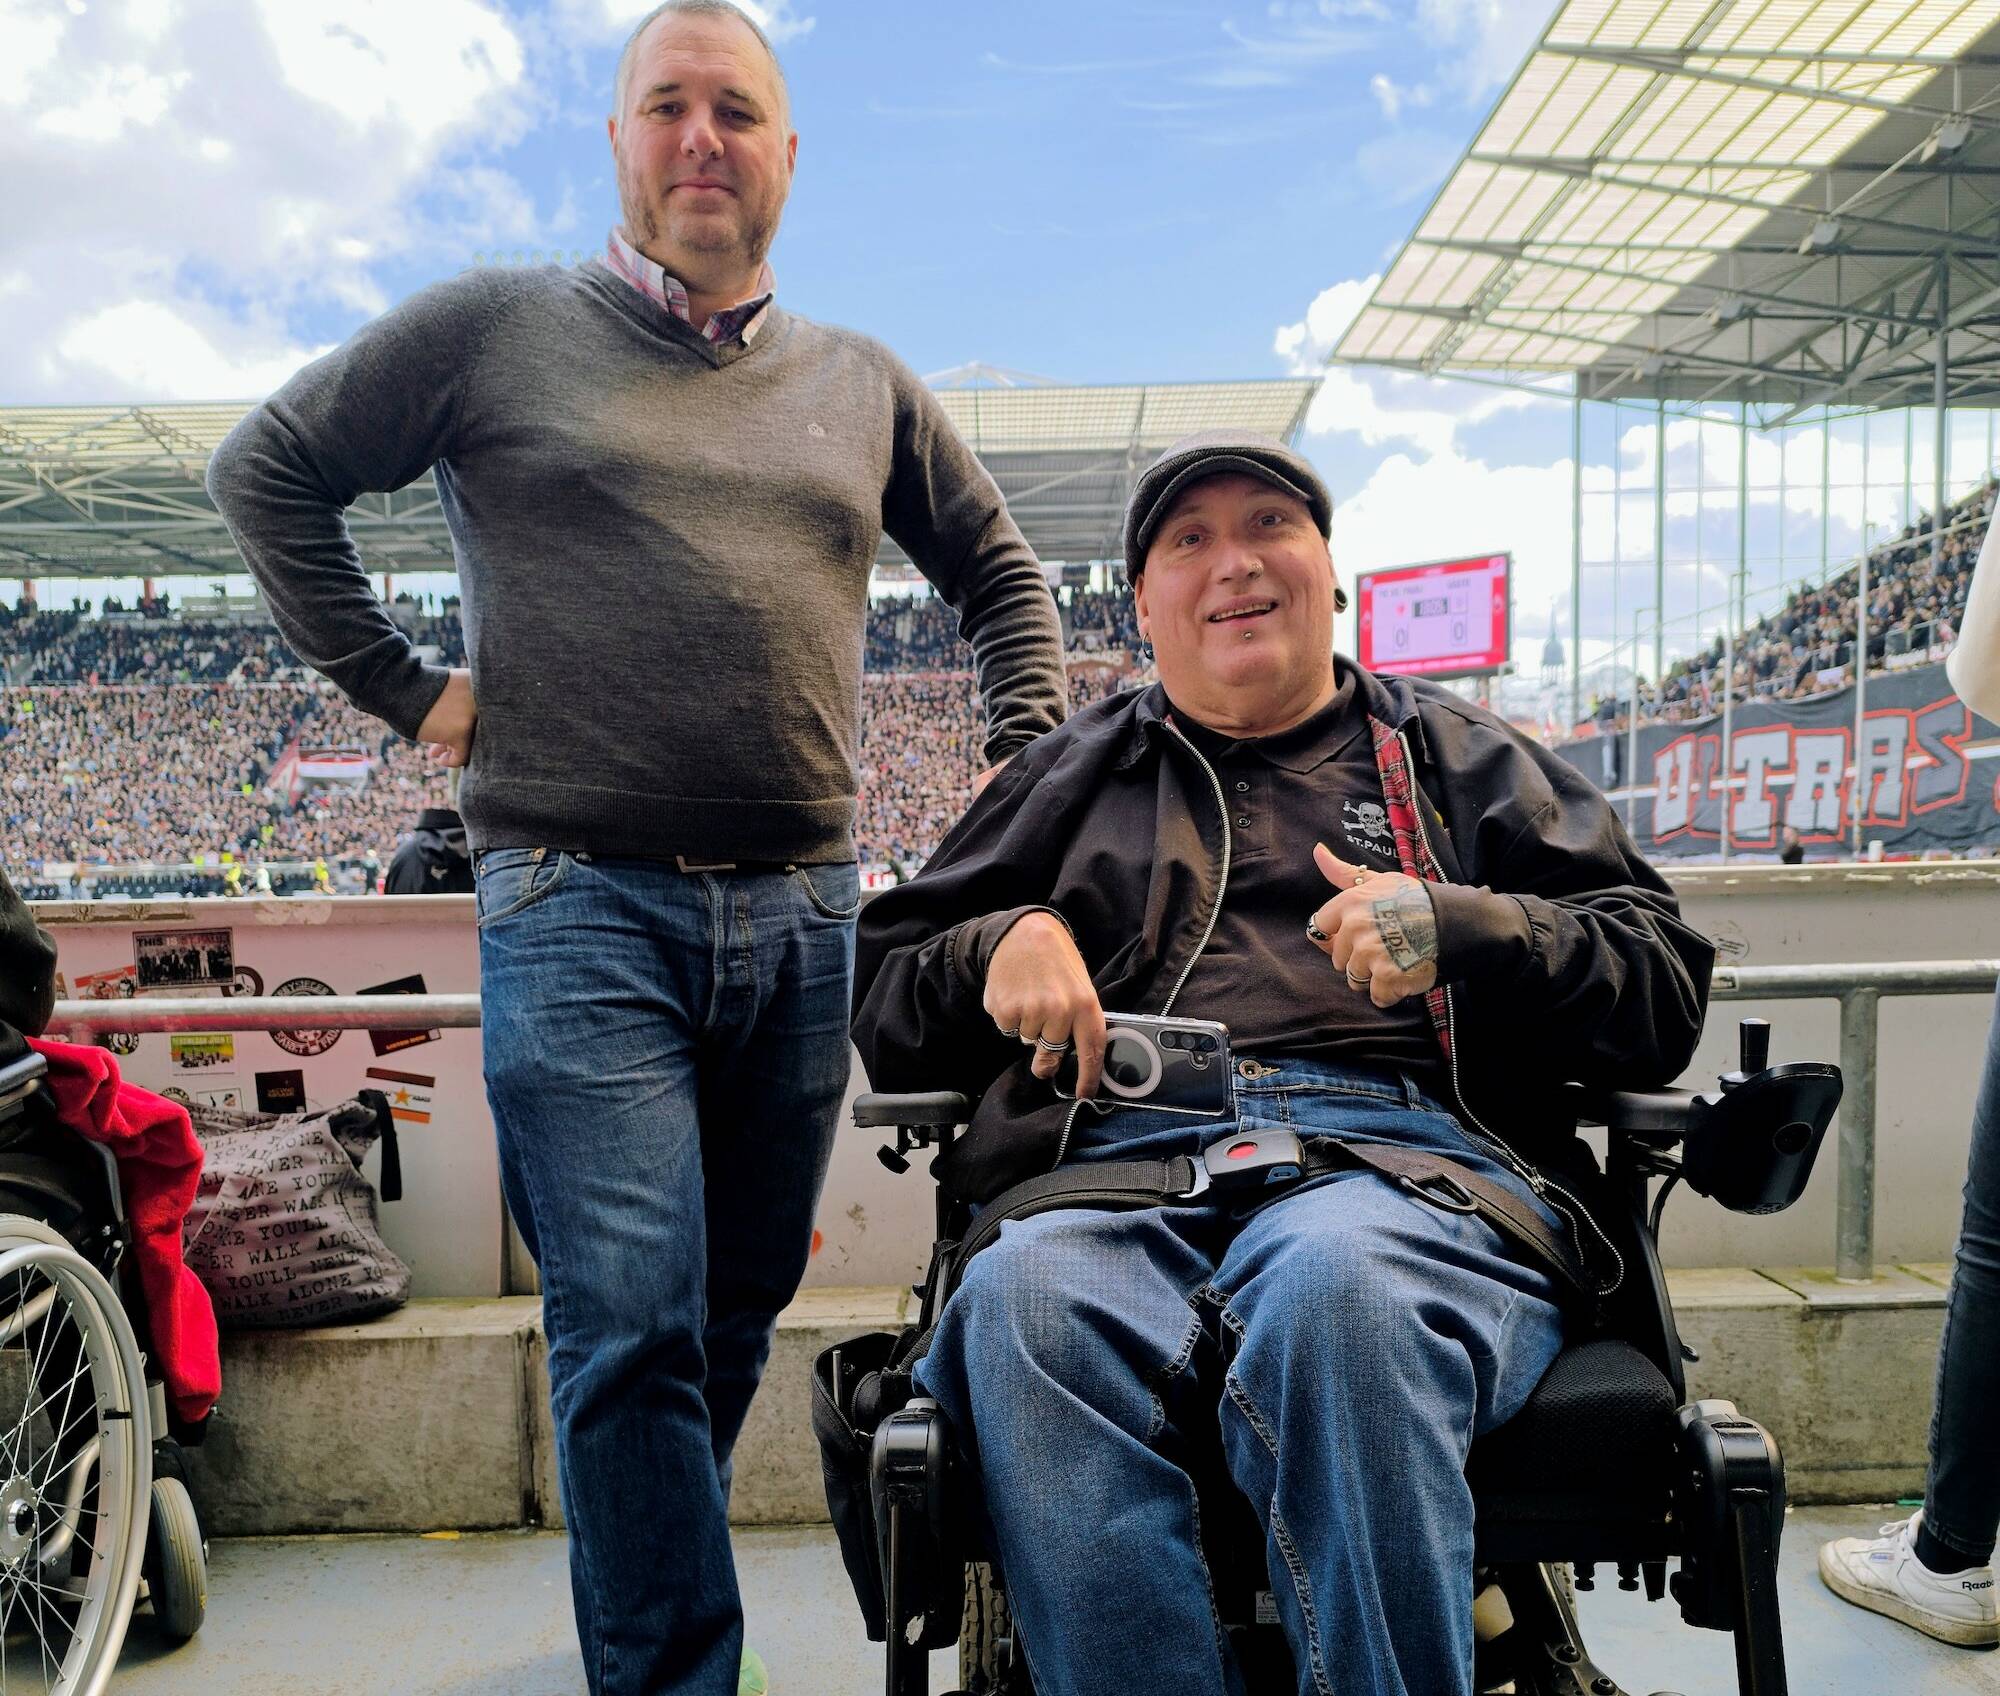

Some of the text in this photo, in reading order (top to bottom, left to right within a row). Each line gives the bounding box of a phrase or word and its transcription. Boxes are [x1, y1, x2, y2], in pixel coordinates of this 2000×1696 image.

[1654, 695, 1973, 848] ULTRAS
[248, 1241, 302, 1266] WALK
[220, 1292, 274, 1310] WALK
[288, 1271, 352, 1302] ALONE
[226, 1266, 297, 1290] YOU'LL
